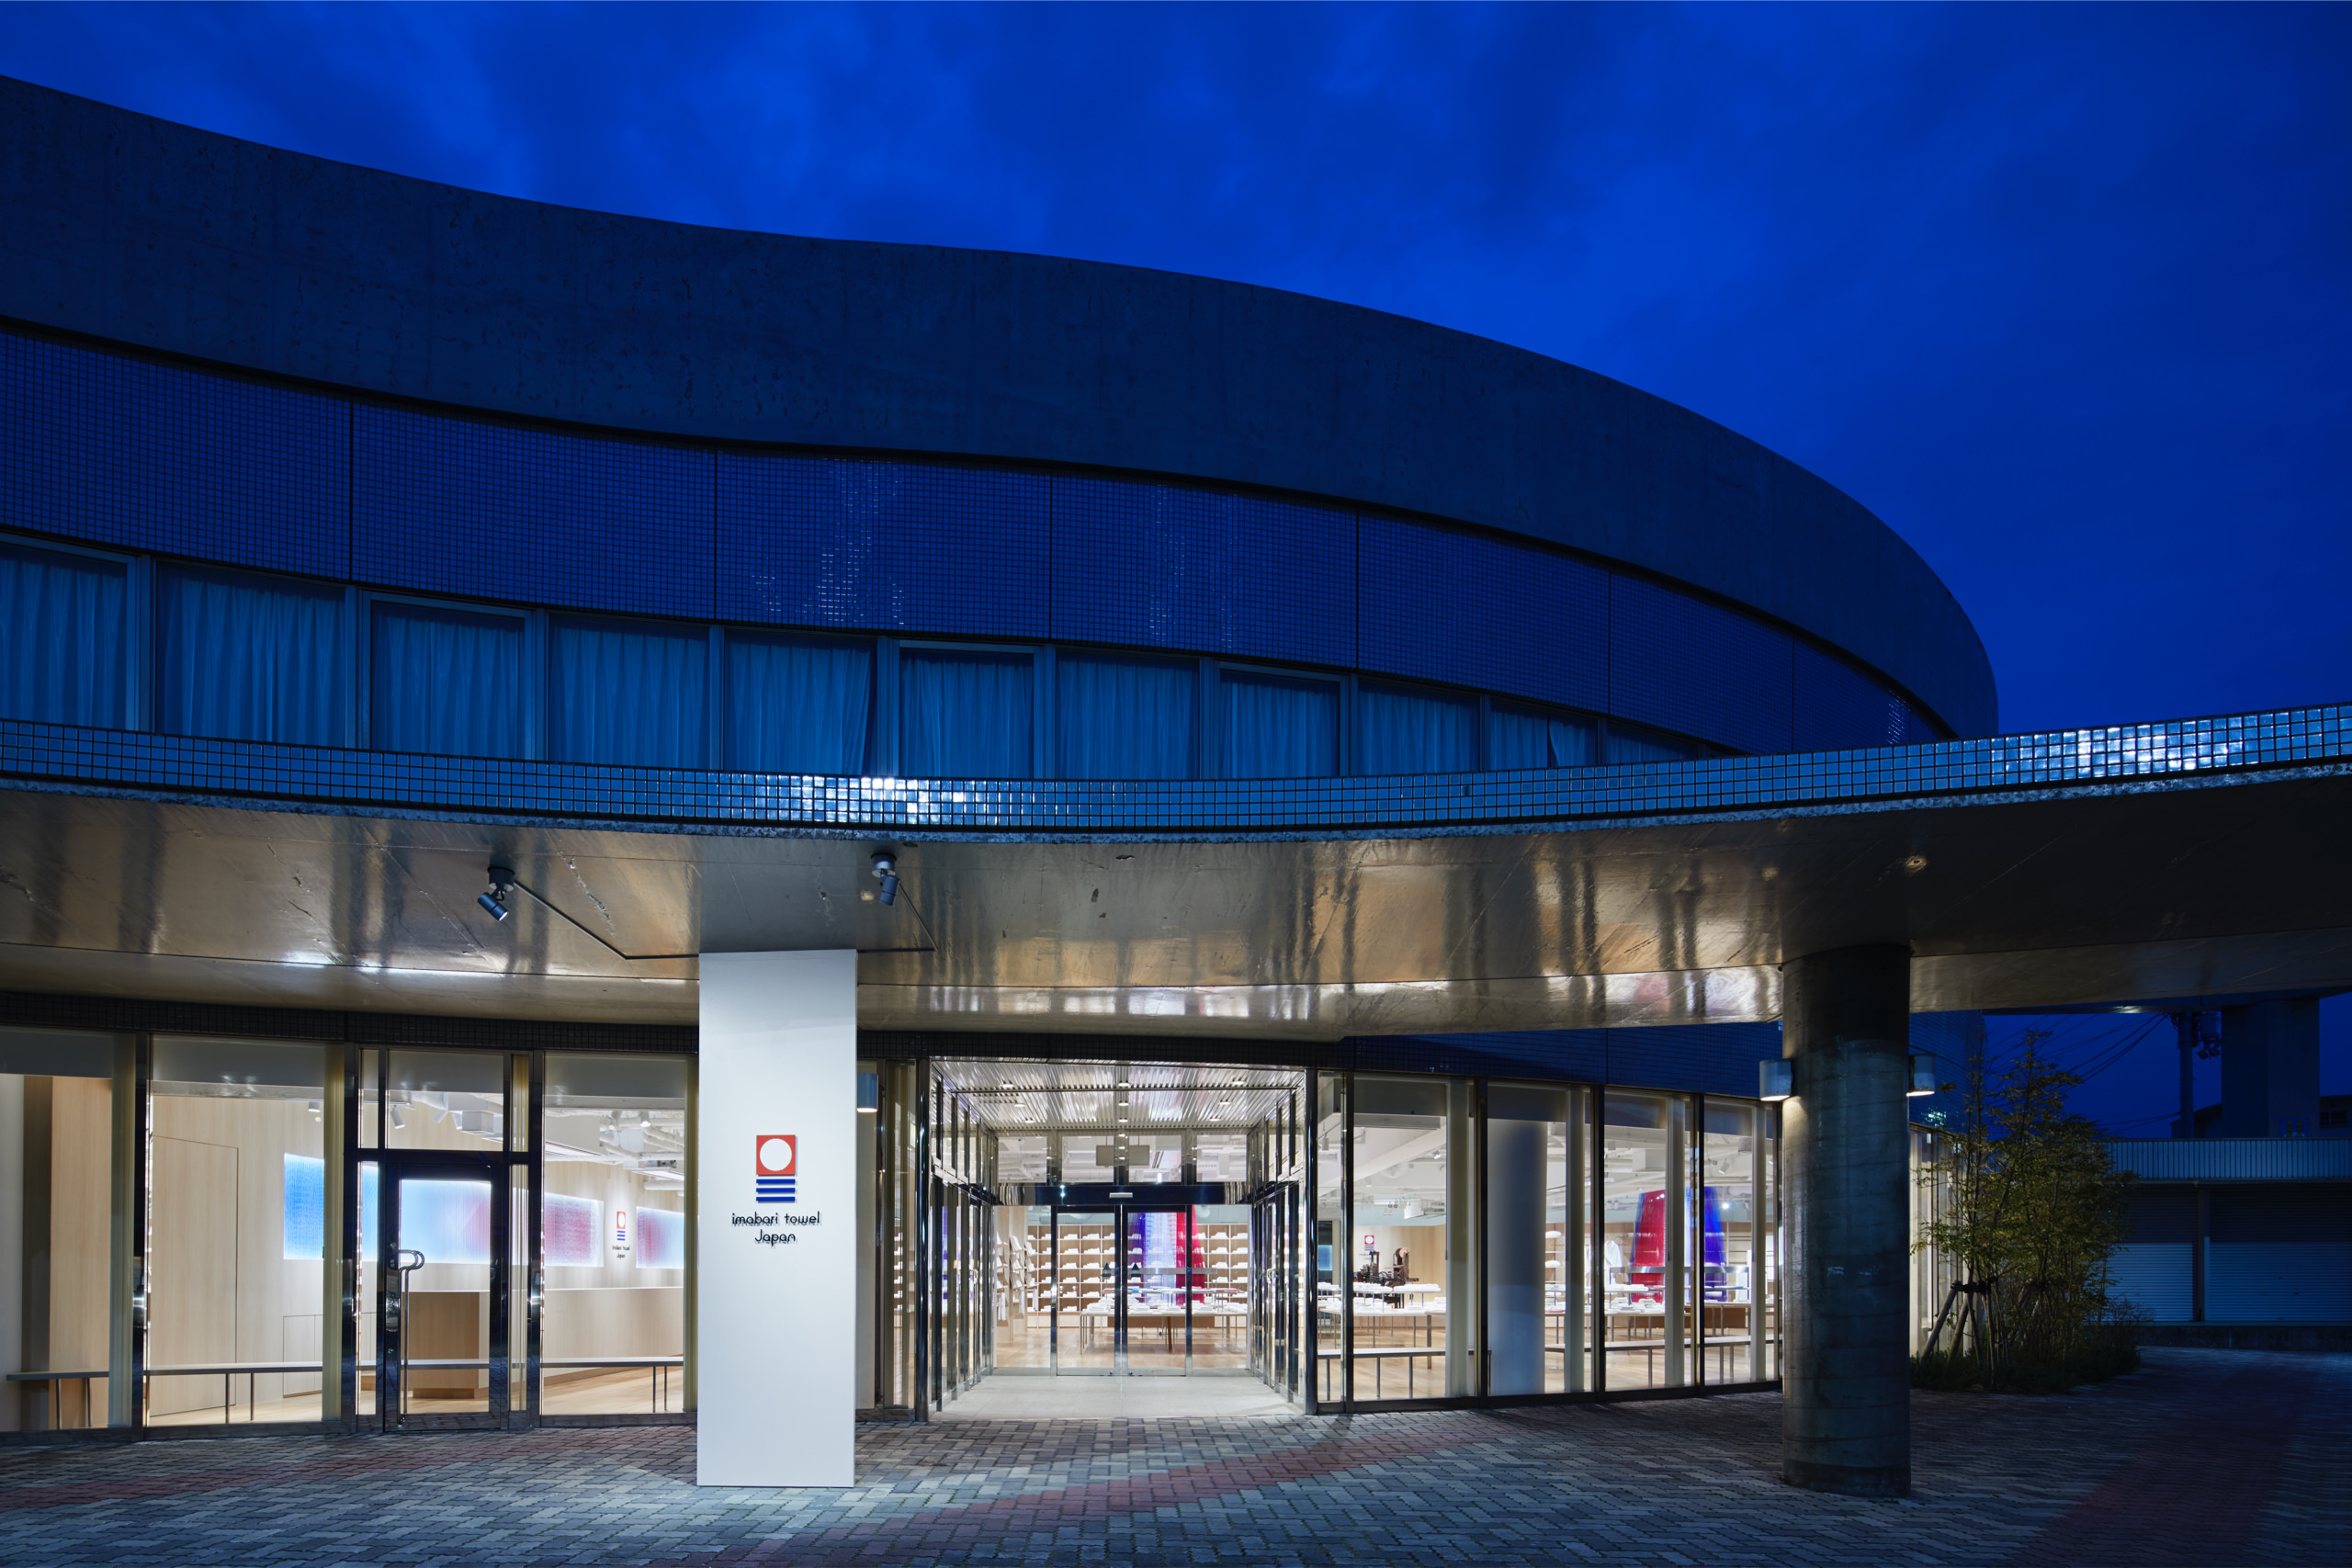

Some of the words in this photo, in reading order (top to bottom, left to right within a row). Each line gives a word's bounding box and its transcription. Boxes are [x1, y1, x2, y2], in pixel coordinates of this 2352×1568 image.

[731, 1211, 779, 1225] imabari
[784, 1211, 820, 1224] towel
[754, 1228, 797, 1247] Japan
